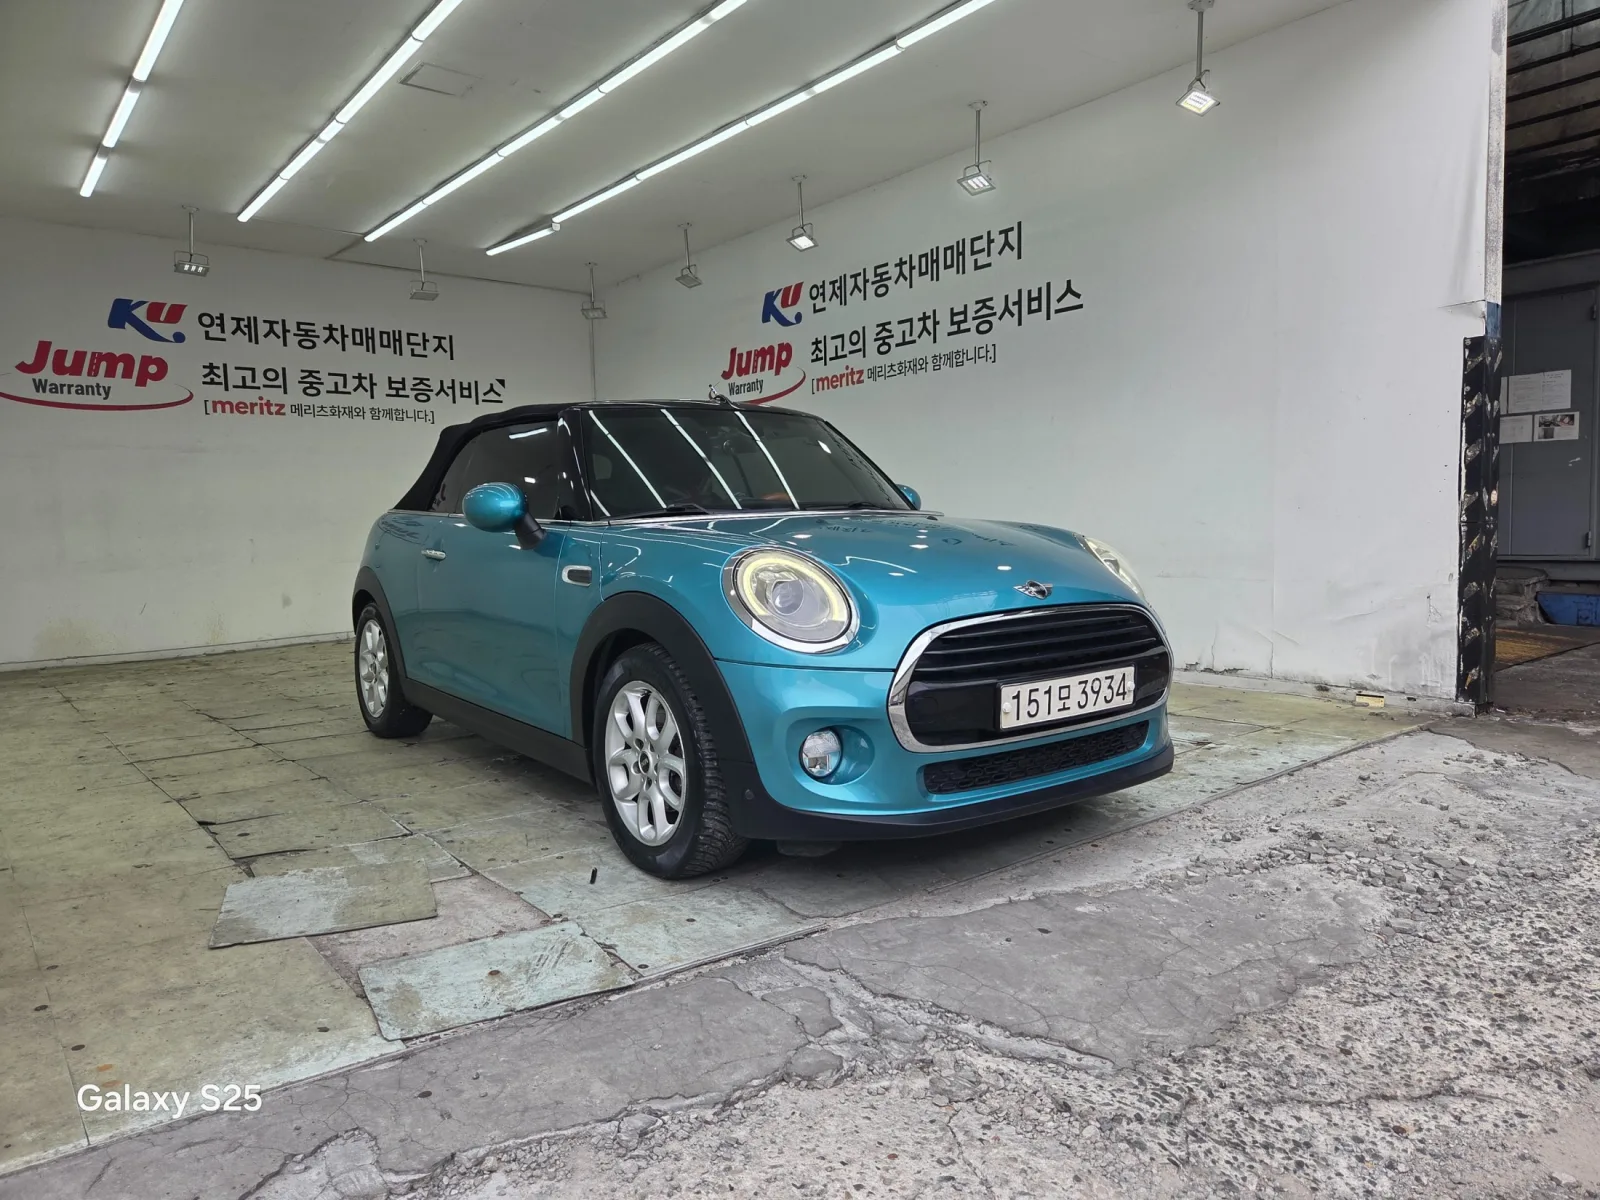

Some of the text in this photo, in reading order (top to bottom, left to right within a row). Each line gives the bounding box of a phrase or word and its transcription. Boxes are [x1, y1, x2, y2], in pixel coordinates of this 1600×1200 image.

[808, 221, 1023, 314] 연제자동차매매단지
[197, 311, 455, 361] 연제자동차매매단지
[810, 278, 1084, 367] 최고의 중고차 보증서비스
[14, 339, 169, 388] Jump
[720, 340, 793, 381] Jump
[866, 352, 929, 383] 메리츠화재와
[930, 343, 997, 371] 함께합니다.]
[31, 377, 112, 401] Warranty
[201, 362, 504, 406] 최고의 중고차 보증서비스
[727, 377, 764, 397] Warranty
[290, 403, 366, 420] 메리츠화재와
[368, 406, 435, 425] 함께합니다.]
